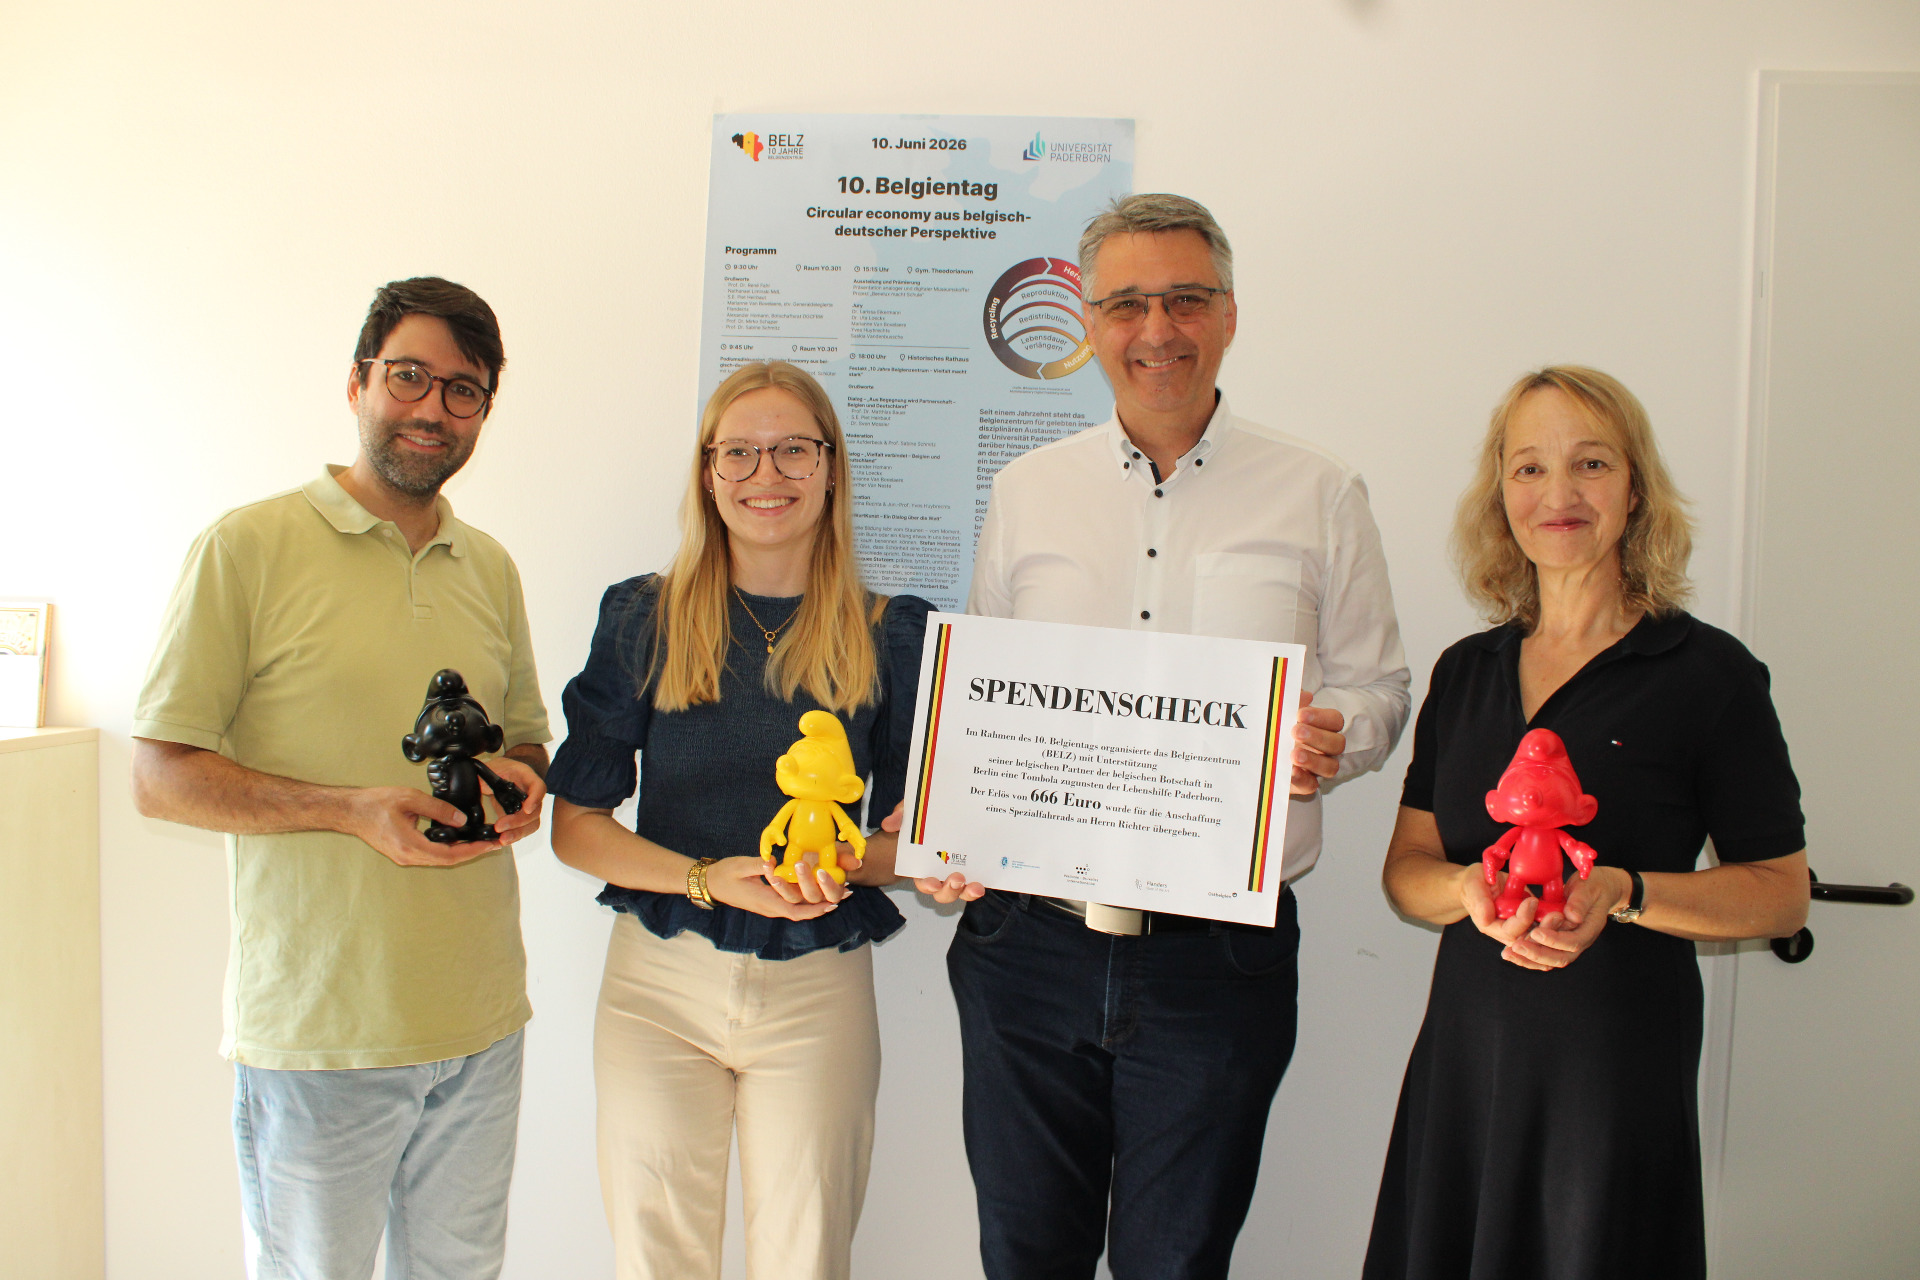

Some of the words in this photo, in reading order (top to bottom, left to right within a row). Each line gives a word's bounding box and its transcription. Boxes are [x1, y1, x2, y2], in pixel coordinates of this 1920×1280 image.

[768, 134, 804, 147] BELZ
[872, 137, 893, 149] 10.
[895, 138, 926, 150] Juni
[929, 138, 967, 151] 2026
[768, 147, 777, 155] 10
[778, 147, 804, 155] JAHRE
[1050, 143, 1113, 153] UNIVERSITÄT
[1050, 153, 1111, 163] PADERBORN
[838, 176, 871, 194] 10.
[875, 177, 998, 201] Belgientag
[806, 207, 864, 219] Circular
[865, 210, 932, 222] economy
[934, 211, 961, 221] aus
[963, 210, 1032, 224] belgisch-
[834, 226, 908, 237] deutscher
[910, 226, 997, 241] Perspektive
[725, 246, 777, 256] Programm
[1020, 289, 1069, 301] Reproduktion
[988, 296, 1001, 340] Recycling
[1018, 313, 1069, 326] Redistribution
[1020, 335, 1068, 346] Lebensdauer
[1024, 341, 1063, 352] verlängern
[1063, 344, 1093, 369] Nutzung
[1016, 410, 1052, 418] Jahrzehnt
[979, 417, 1034, 425] Belgienzentrum
[1034, 418, 1045, 426] für
[978, 425, 1023, 433] disziplinären
[1024, 427, 1062, 435] Austausch
[991, 434, 1030, 442] Universität
[977, 441, 1006, 449] darüber
[968, 677, 1248, 730] SPENDENSCHECK
[966, 727, 978, 737] Im
[980, 729, 1016, 741] Rahmen
[1018, 733, 1032, 742] des
[1035, 735, 1047, 744] 10.
[1049, 737, 1099, 751] Belgientags
[1100, 746, 1151, 755] organisierte
[1153, 748, 1168, 757] das
[1171, 750, 1241, 765] Belgienzentrum
[1041, 749, 1077, 761] (BELZ)
[1079, 754, 1093, 763] mit
[1096, 755, 1158, 771] Unterstützung
[988, 756, 1014, 766] seiner
[1015, 759, 1060, 771] belgischen
[1062, 764, 1095, 775] Partner
[1096, 768, 1110, 777] der
[1112, 770, 1157, 782] belgischen
[1159, 775, 1201, 787] Botschaft
[1204, 780, 1213, 789] in
[973, 766, 999, 777] Berlin
[1001, 770, 1019, 779] eine
[1021, 772, 1058, 784] Tombola
[1060, 779, 1104, 789] zugunsten
[1106, 782, 1120, 791] der
[1123, 784, 1172, 797] Lebenshilfe
[1174, 790, 1223, 803] Paderborn.
[988, 788, 1010, 798] Erlös
[1030, 789, 1058, 804] 666
[1064, 792, 1101, 809] Euro
[1105, 805, 1132, 813] wurde
[1134, 806, 1147, 815] für
[1165, 811, 1221, 826] Anschaffung
[985, 804, 1007, 813] eines
[1008, 807, 1074, 822] Spezialfahrrads
[1090, 816, 1116, 827] Herrn
[1118, 820, 1151, 831] Richter
[1153, 825, 1200, 837] übergeben.
